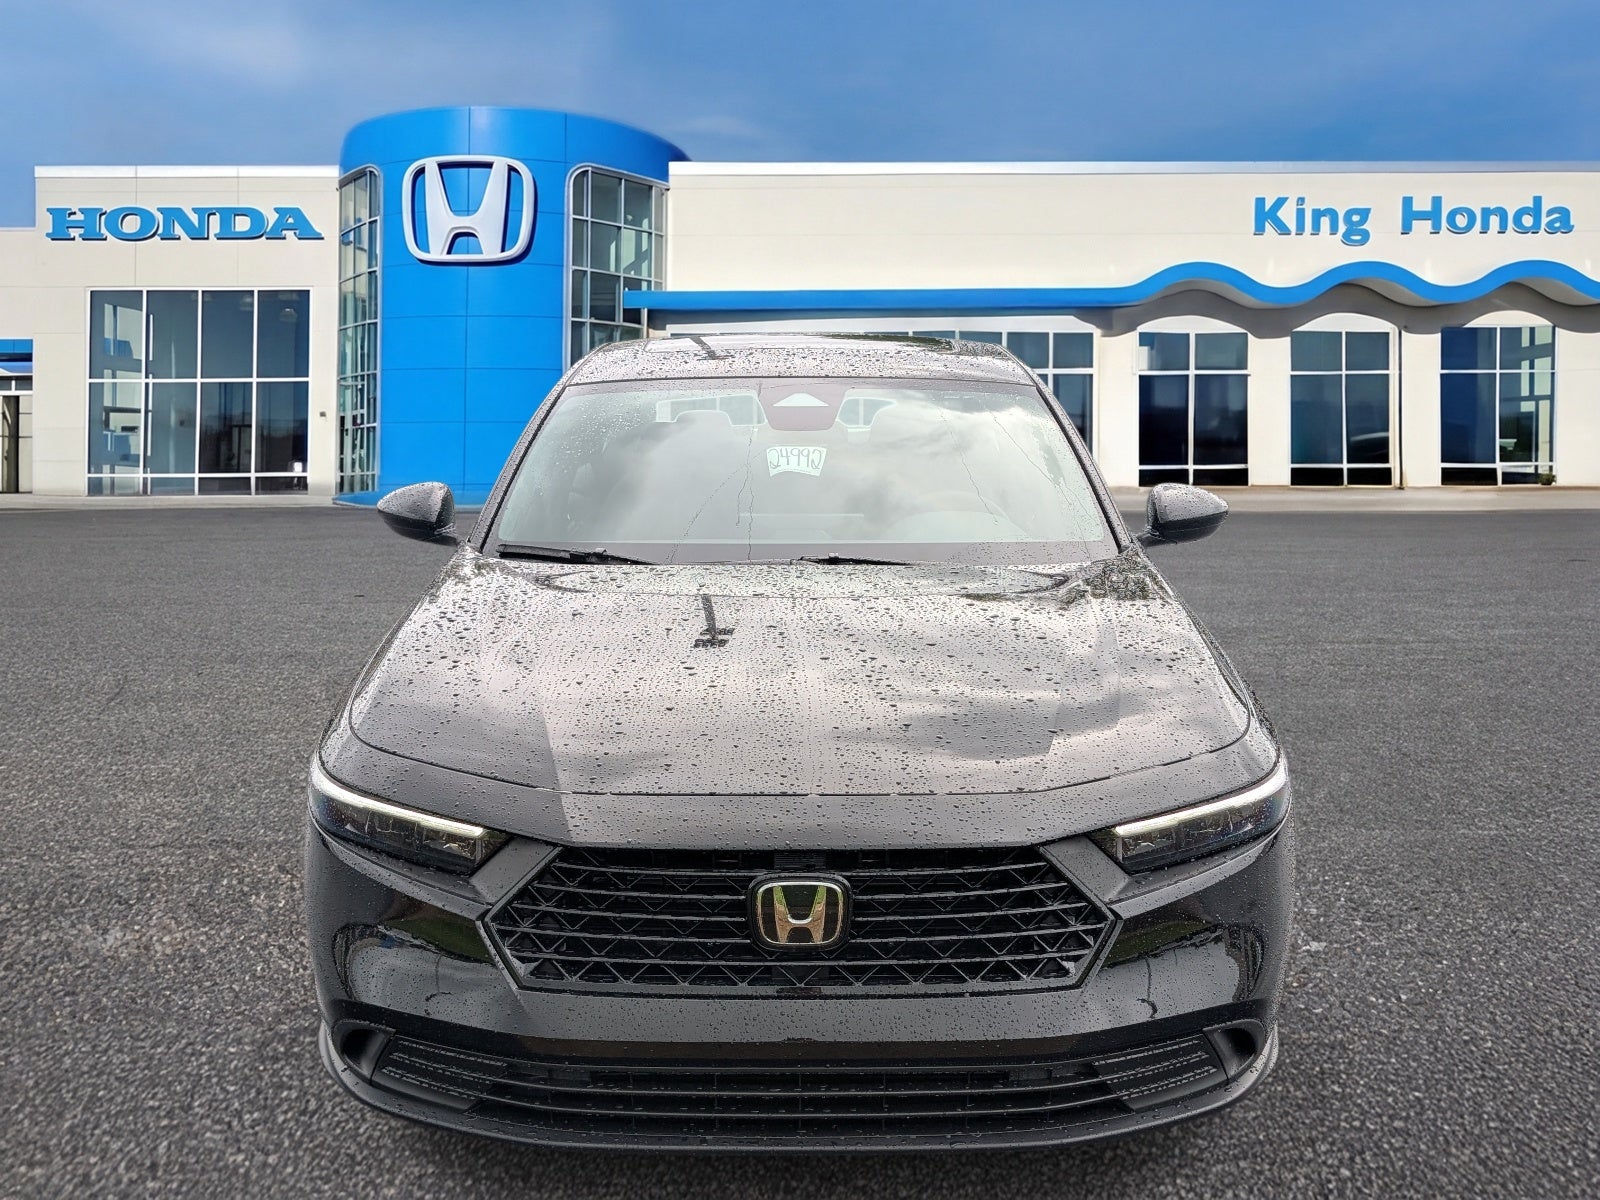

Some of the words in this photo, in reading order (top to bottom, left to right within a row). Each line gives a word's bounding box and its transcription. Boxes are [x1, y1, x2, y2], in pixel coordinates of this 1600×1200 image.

[46, 206, 324, 241] HONDA
[1253, 196, 1372, 246] King
[1401, 195, 1575, 235] Honda
[767, 447, 822, 470] 24992
